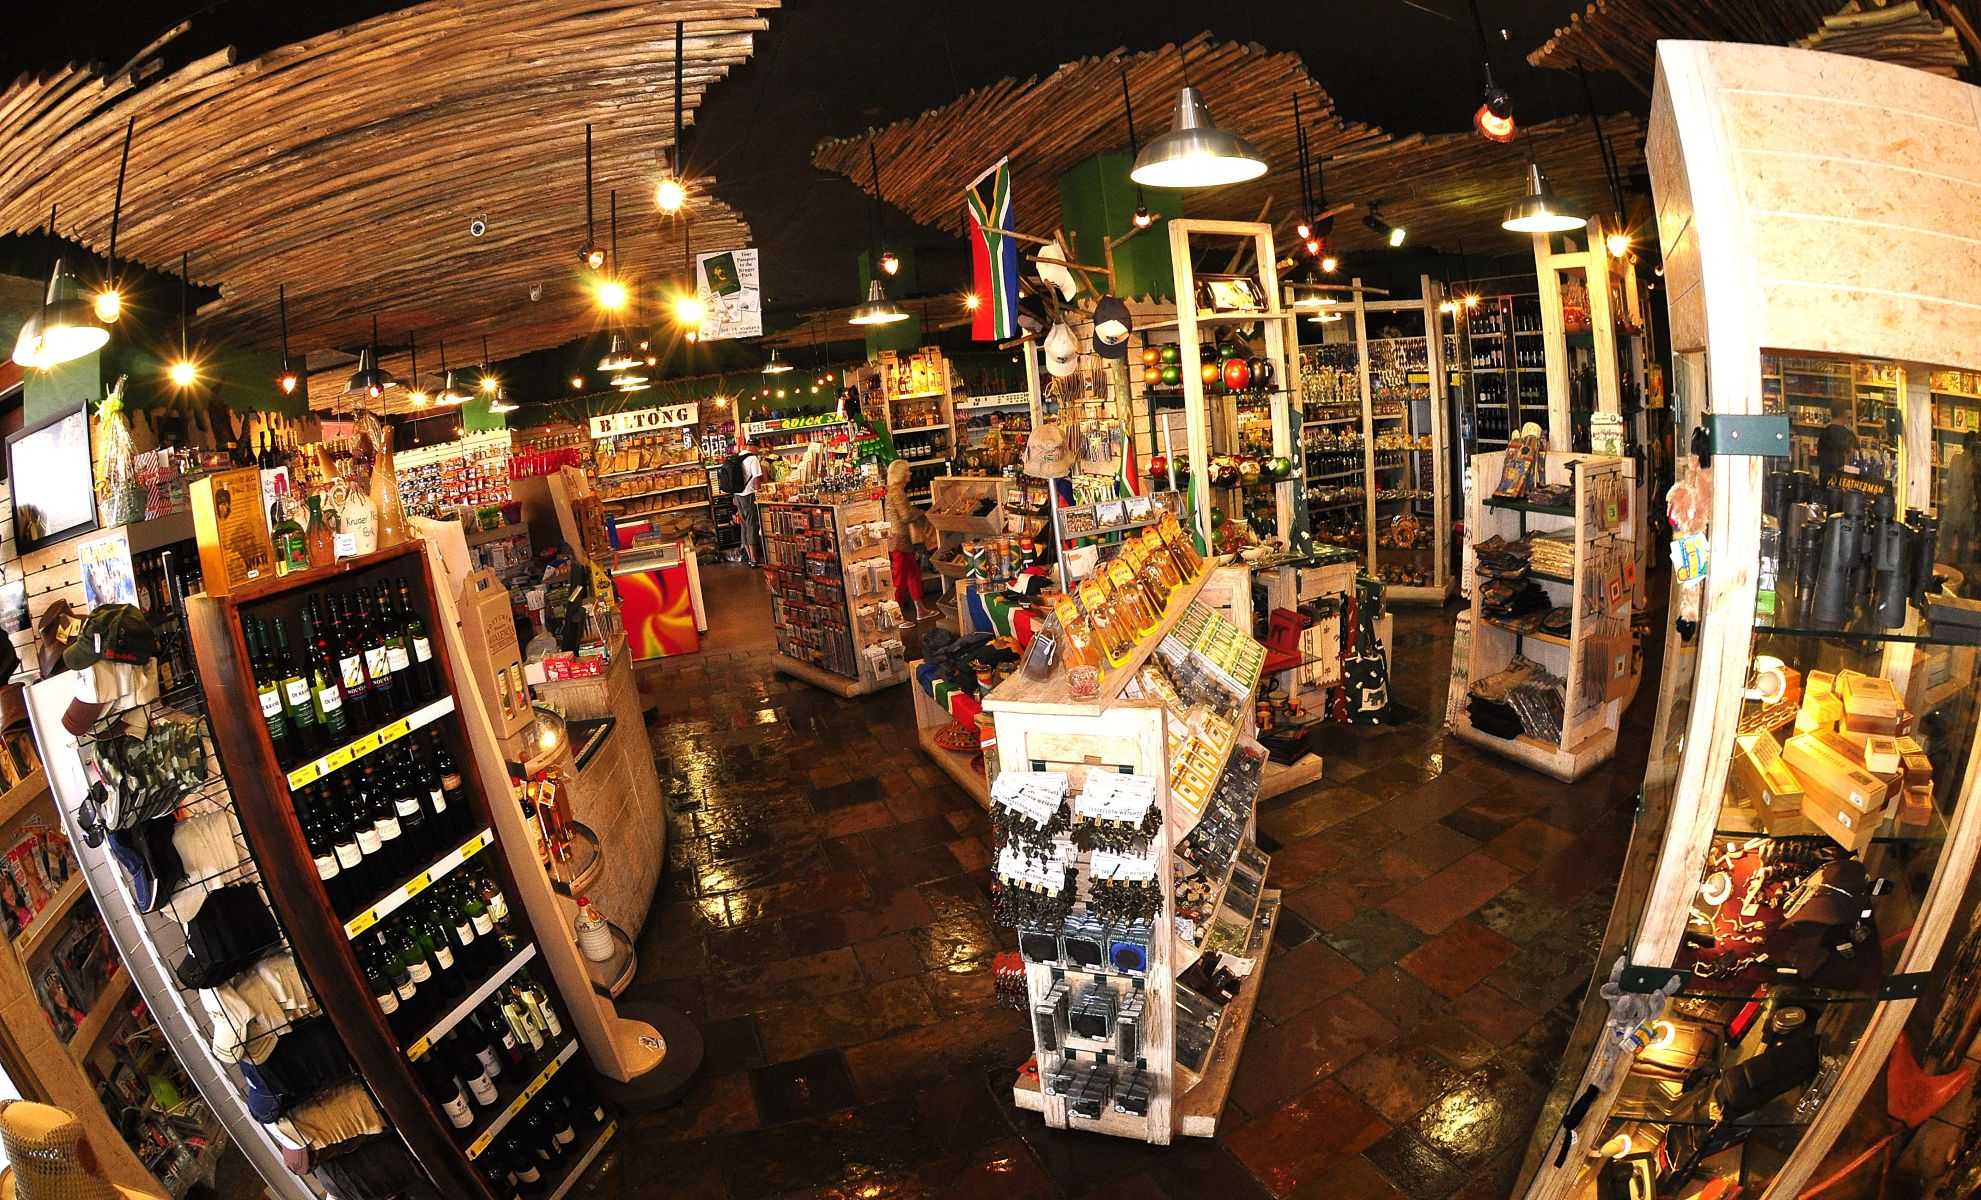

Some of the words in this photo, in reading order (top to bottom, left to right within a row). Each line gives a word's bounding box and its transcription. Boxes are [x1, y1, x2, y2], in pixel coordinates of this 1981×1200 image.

[736, 256, 757, 264] Passport
[599, 408, 689, 433] BILTONG
[781, 415, 824, 430] QUICK
[1839, 477, 1885, 494] LEATHERMAN
